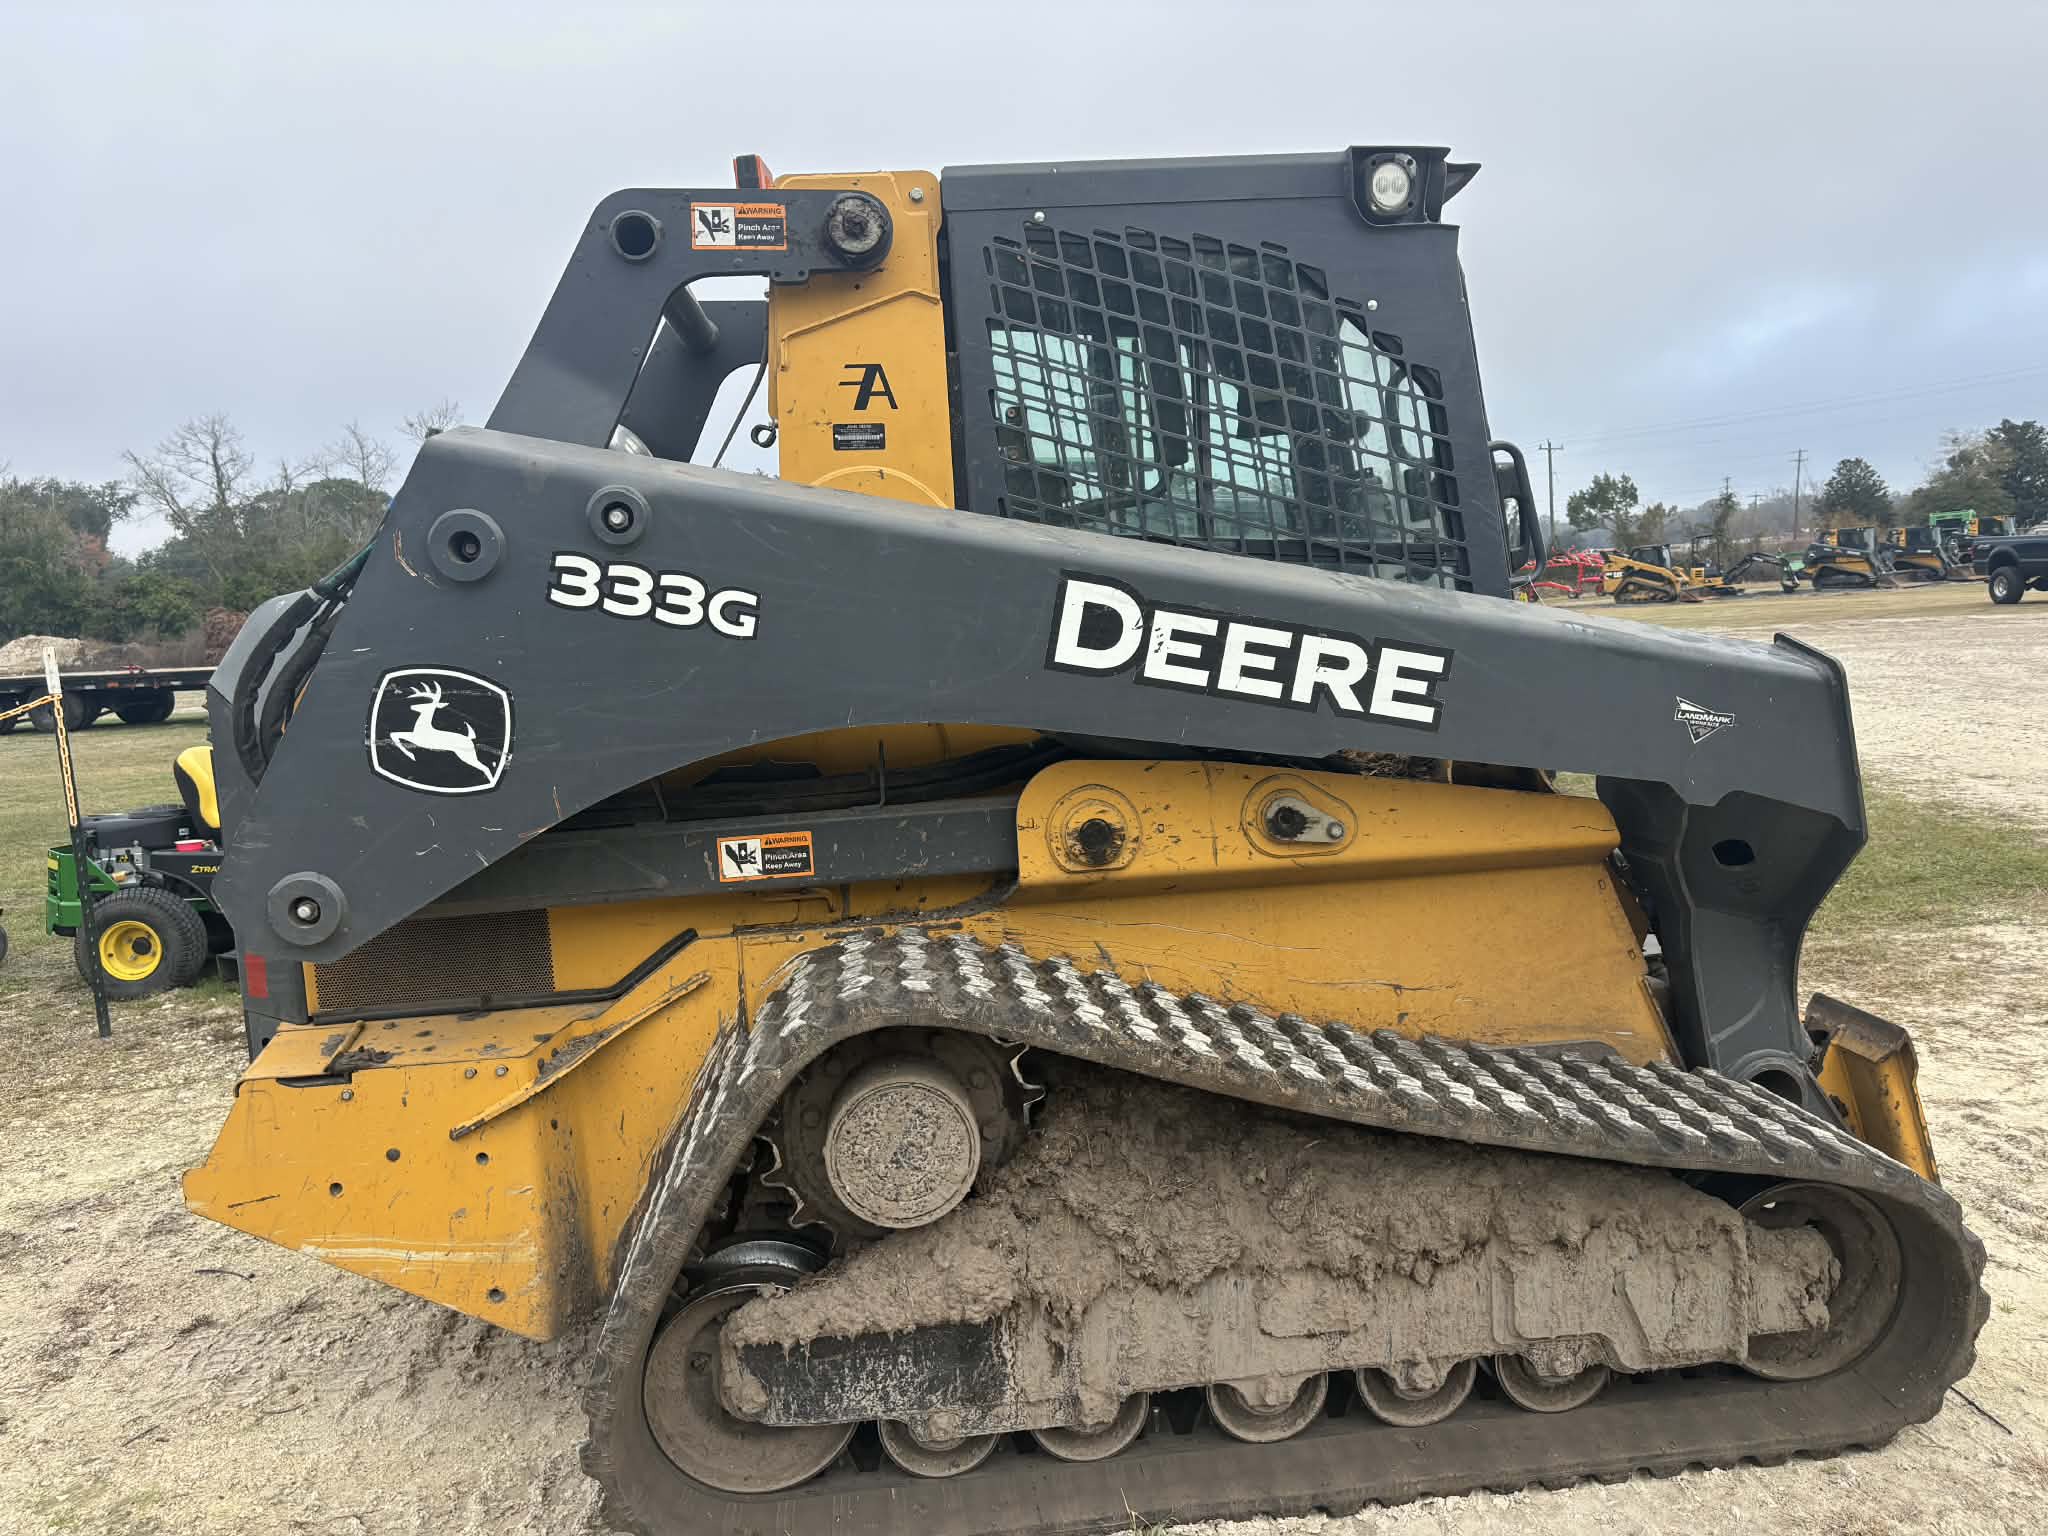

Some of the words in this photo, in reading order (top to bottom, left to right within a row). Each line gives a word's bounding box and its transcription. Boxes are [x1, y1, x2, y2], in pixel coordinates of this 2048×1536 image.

[747, 207, 781, 215] WARNING
[738, 223, 760, 231] Pinch
[757, 233, 775, 241] Away
[550, 555, 758, 637] 333G
[1054, 579, 1445, 724] DEERE
[772, 836, 807, 845] WARNING
[764, 853, 787, 861] Pinch
